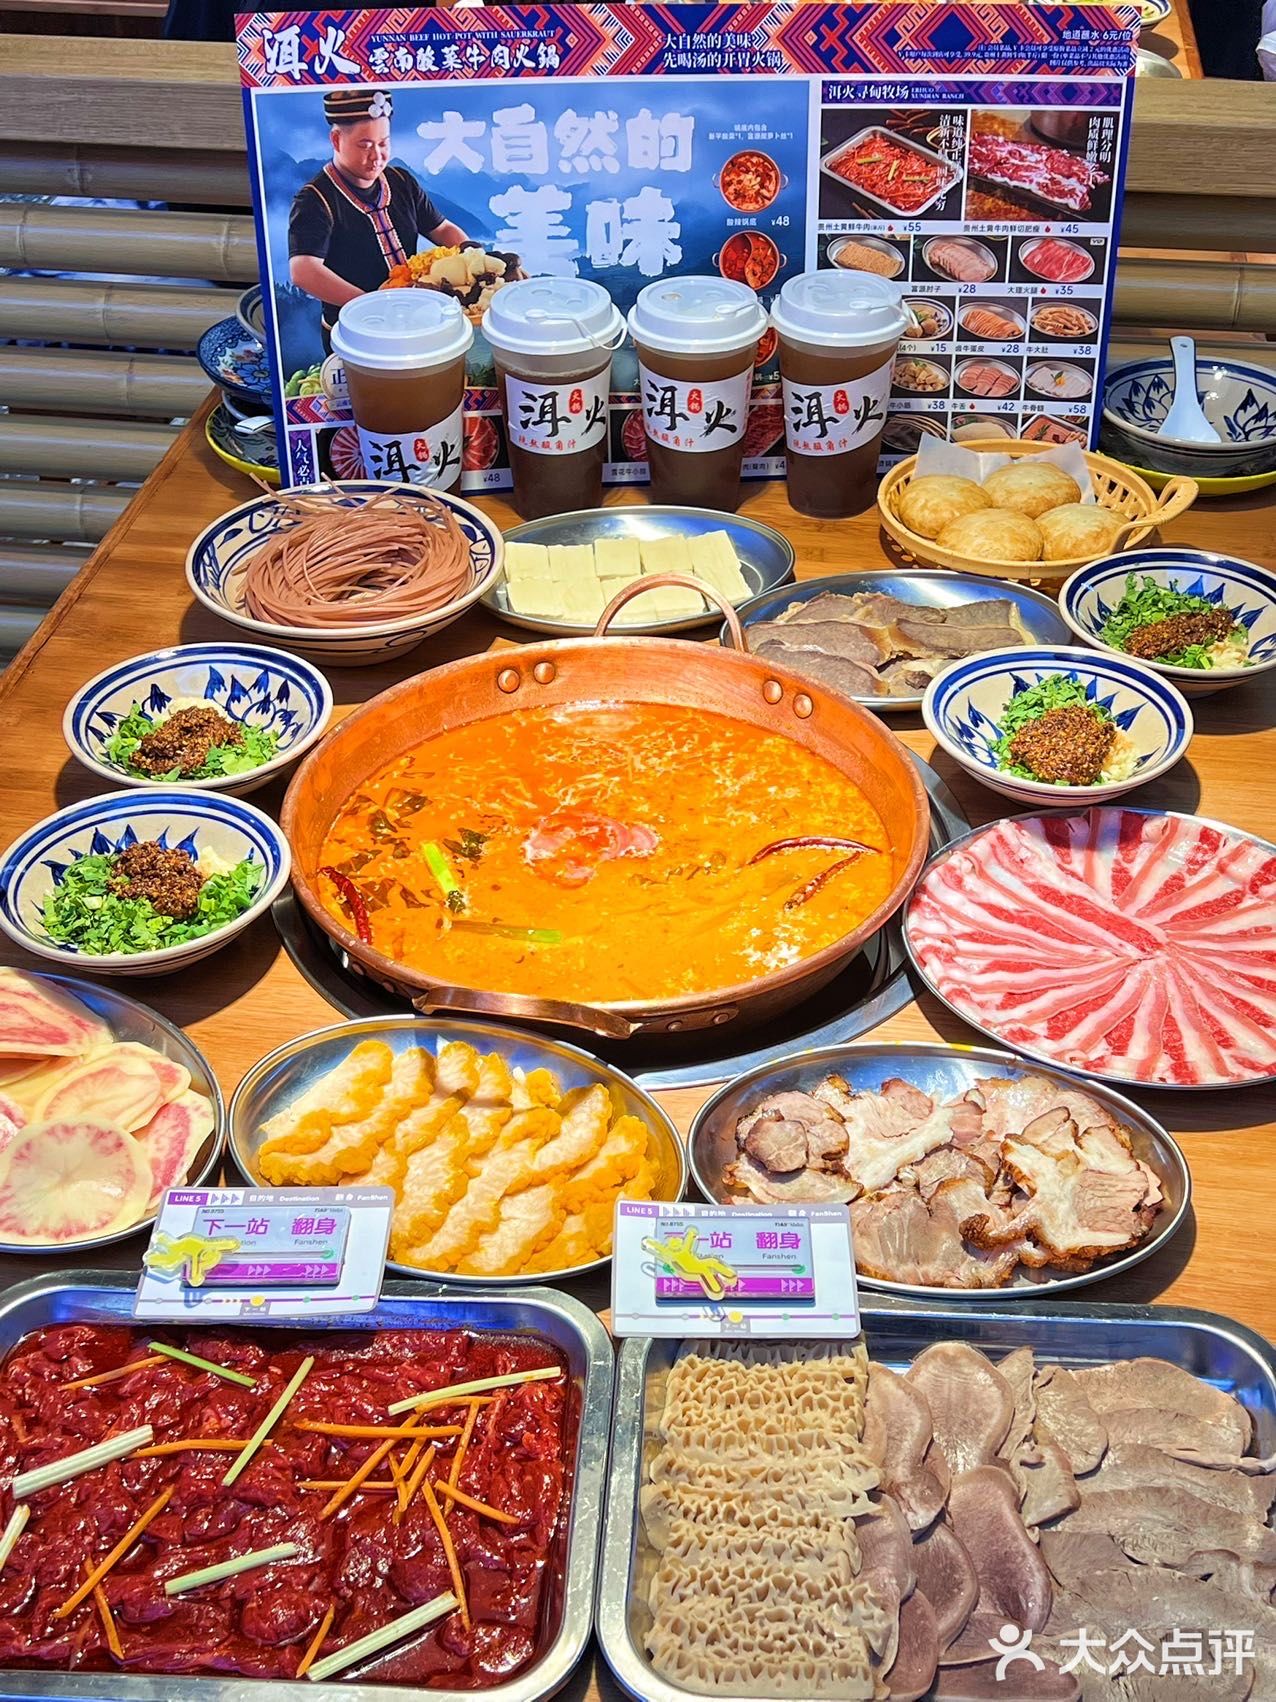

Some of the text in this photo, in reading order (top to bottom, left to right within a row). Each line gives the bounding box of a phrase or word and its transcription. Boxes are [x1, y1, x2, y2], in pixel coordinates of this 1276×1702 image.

[371, 29, 556, 43] YUNNAN BEEF HOT POT WITH SAUERKRAUT
[663, 32, 753, 49] 大自然的美味
[1102, 30, 1133, 41] 6元/位
[261, 25, 361, 81] 洱火
[663, 51, 782, 69] 先喝汤的开胃火锅
[417, 102, 696, 176] 大自然的
[771, 215, 790, 226] ¥48
[903, 222, 922, 232] ¥55
[1061, 223, 1079, 234] ¥45
[958, 284, 977, 294] ¥28
[1055, 285, 1074, 295] ¥35
[931, 343, 947, 353] ¥15
[1001, 343, 1020, 354] ¥28
[1073, 345, 1092, 355] ¥38
[689, 391, 702, 411] 火锅
[835, 390, 848, 412] 火锅
[928, 400, 946, 411] ¥38
[645, 379, 738, 438] 洱火
[997, 402, 1015, 412] ¥42
[1068, 403, 1087, 414] ¥58
[791, 391, 884, 439] 洱火
[483, 472, 500, 483] ¥48
[626, 1206, 646, 1215] LINE
[203, 1217, 337, 1236] 下一站 翻身
[294, 1238, 328, 1246] Fanshen
[755, 1231, 801, 1249] 翻身
